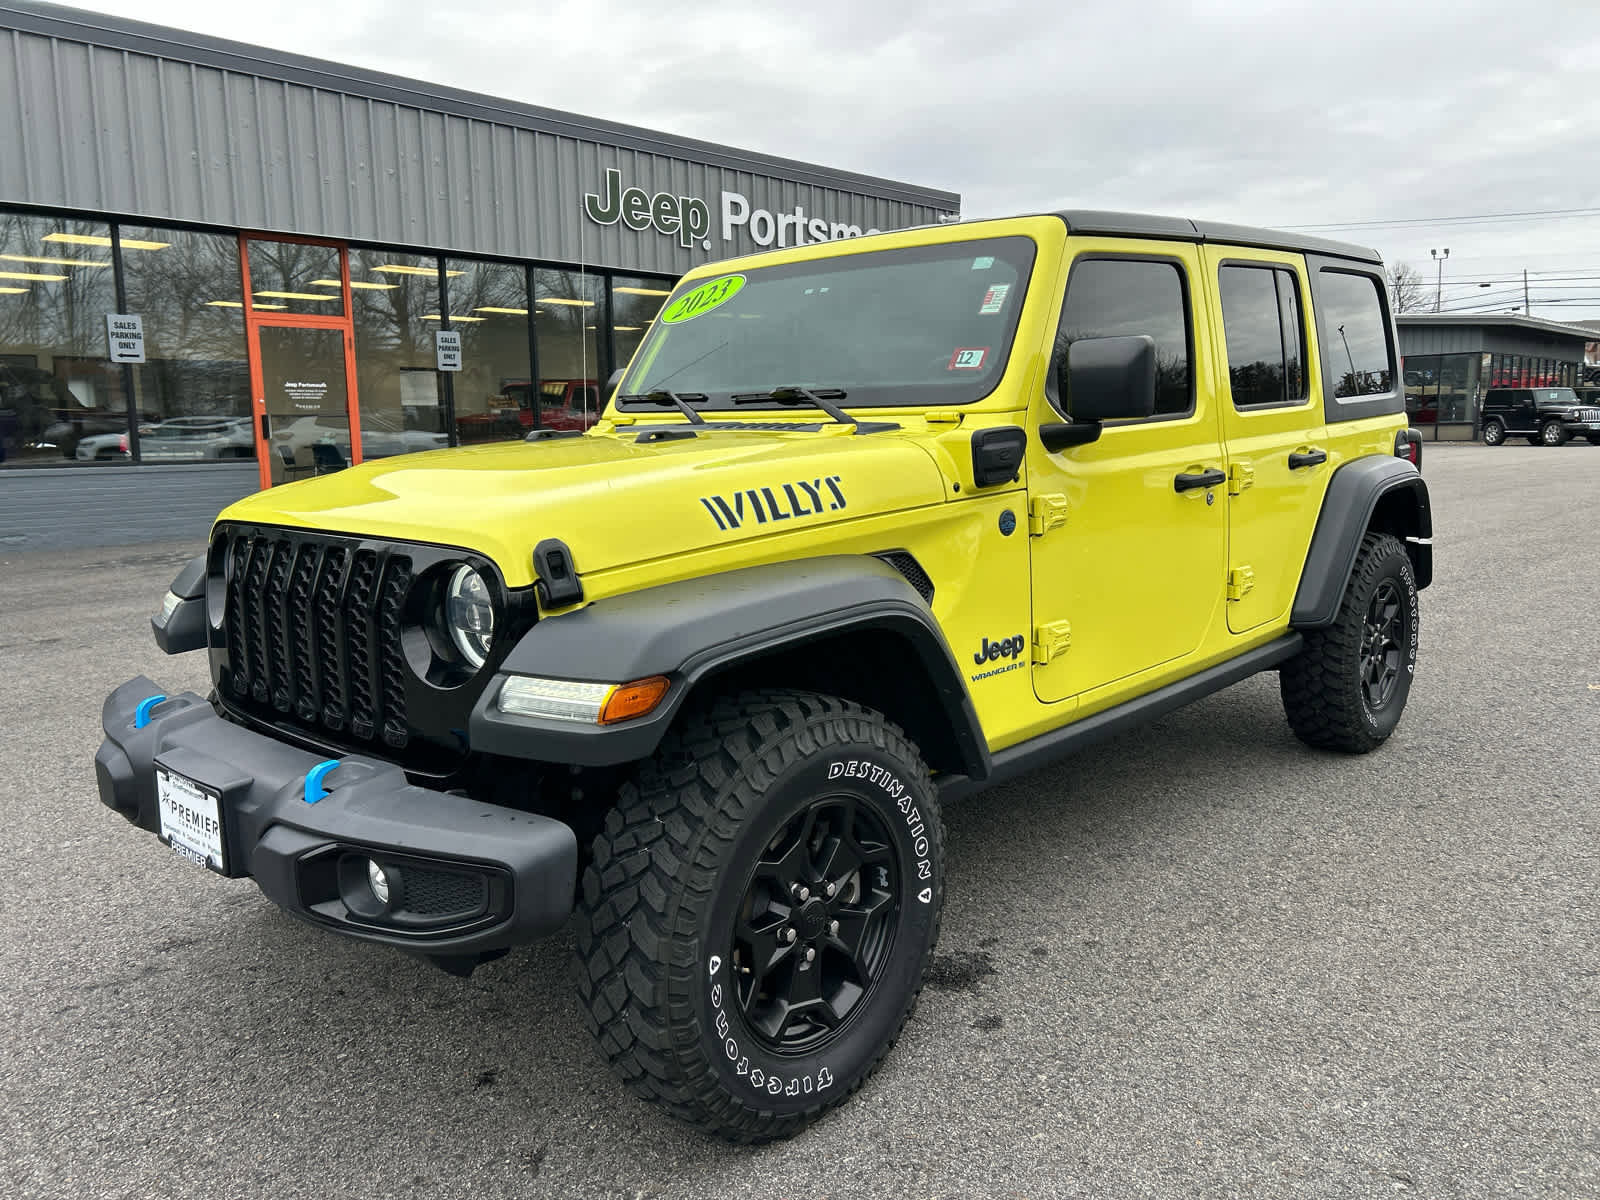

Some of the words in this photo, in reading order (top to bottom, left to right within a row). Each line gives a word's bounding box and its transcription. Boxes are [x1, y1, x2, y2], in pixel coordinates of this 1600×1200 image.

[584, 168, 710, 248] Jeep
[721, 191, 882, 248] Portsm
[671, 278, 733, 320] 2023
[110, 331, 142, 340] PARKING
[113, 321, 137, 330] SALES
[118, 341, 136, 350] ONLY
[956, 351, 974, 365] 12
[699, 475, 847, 531] WILLYS
[973, 634, 1025, 666] Jeep
[971, 663, 1018, 682] WRANGLER
[171, 800, 218, 836] PREMIER
[827, 760, 933, 880] DESTINATION
[171, 840, 207, 869] PREMIER
